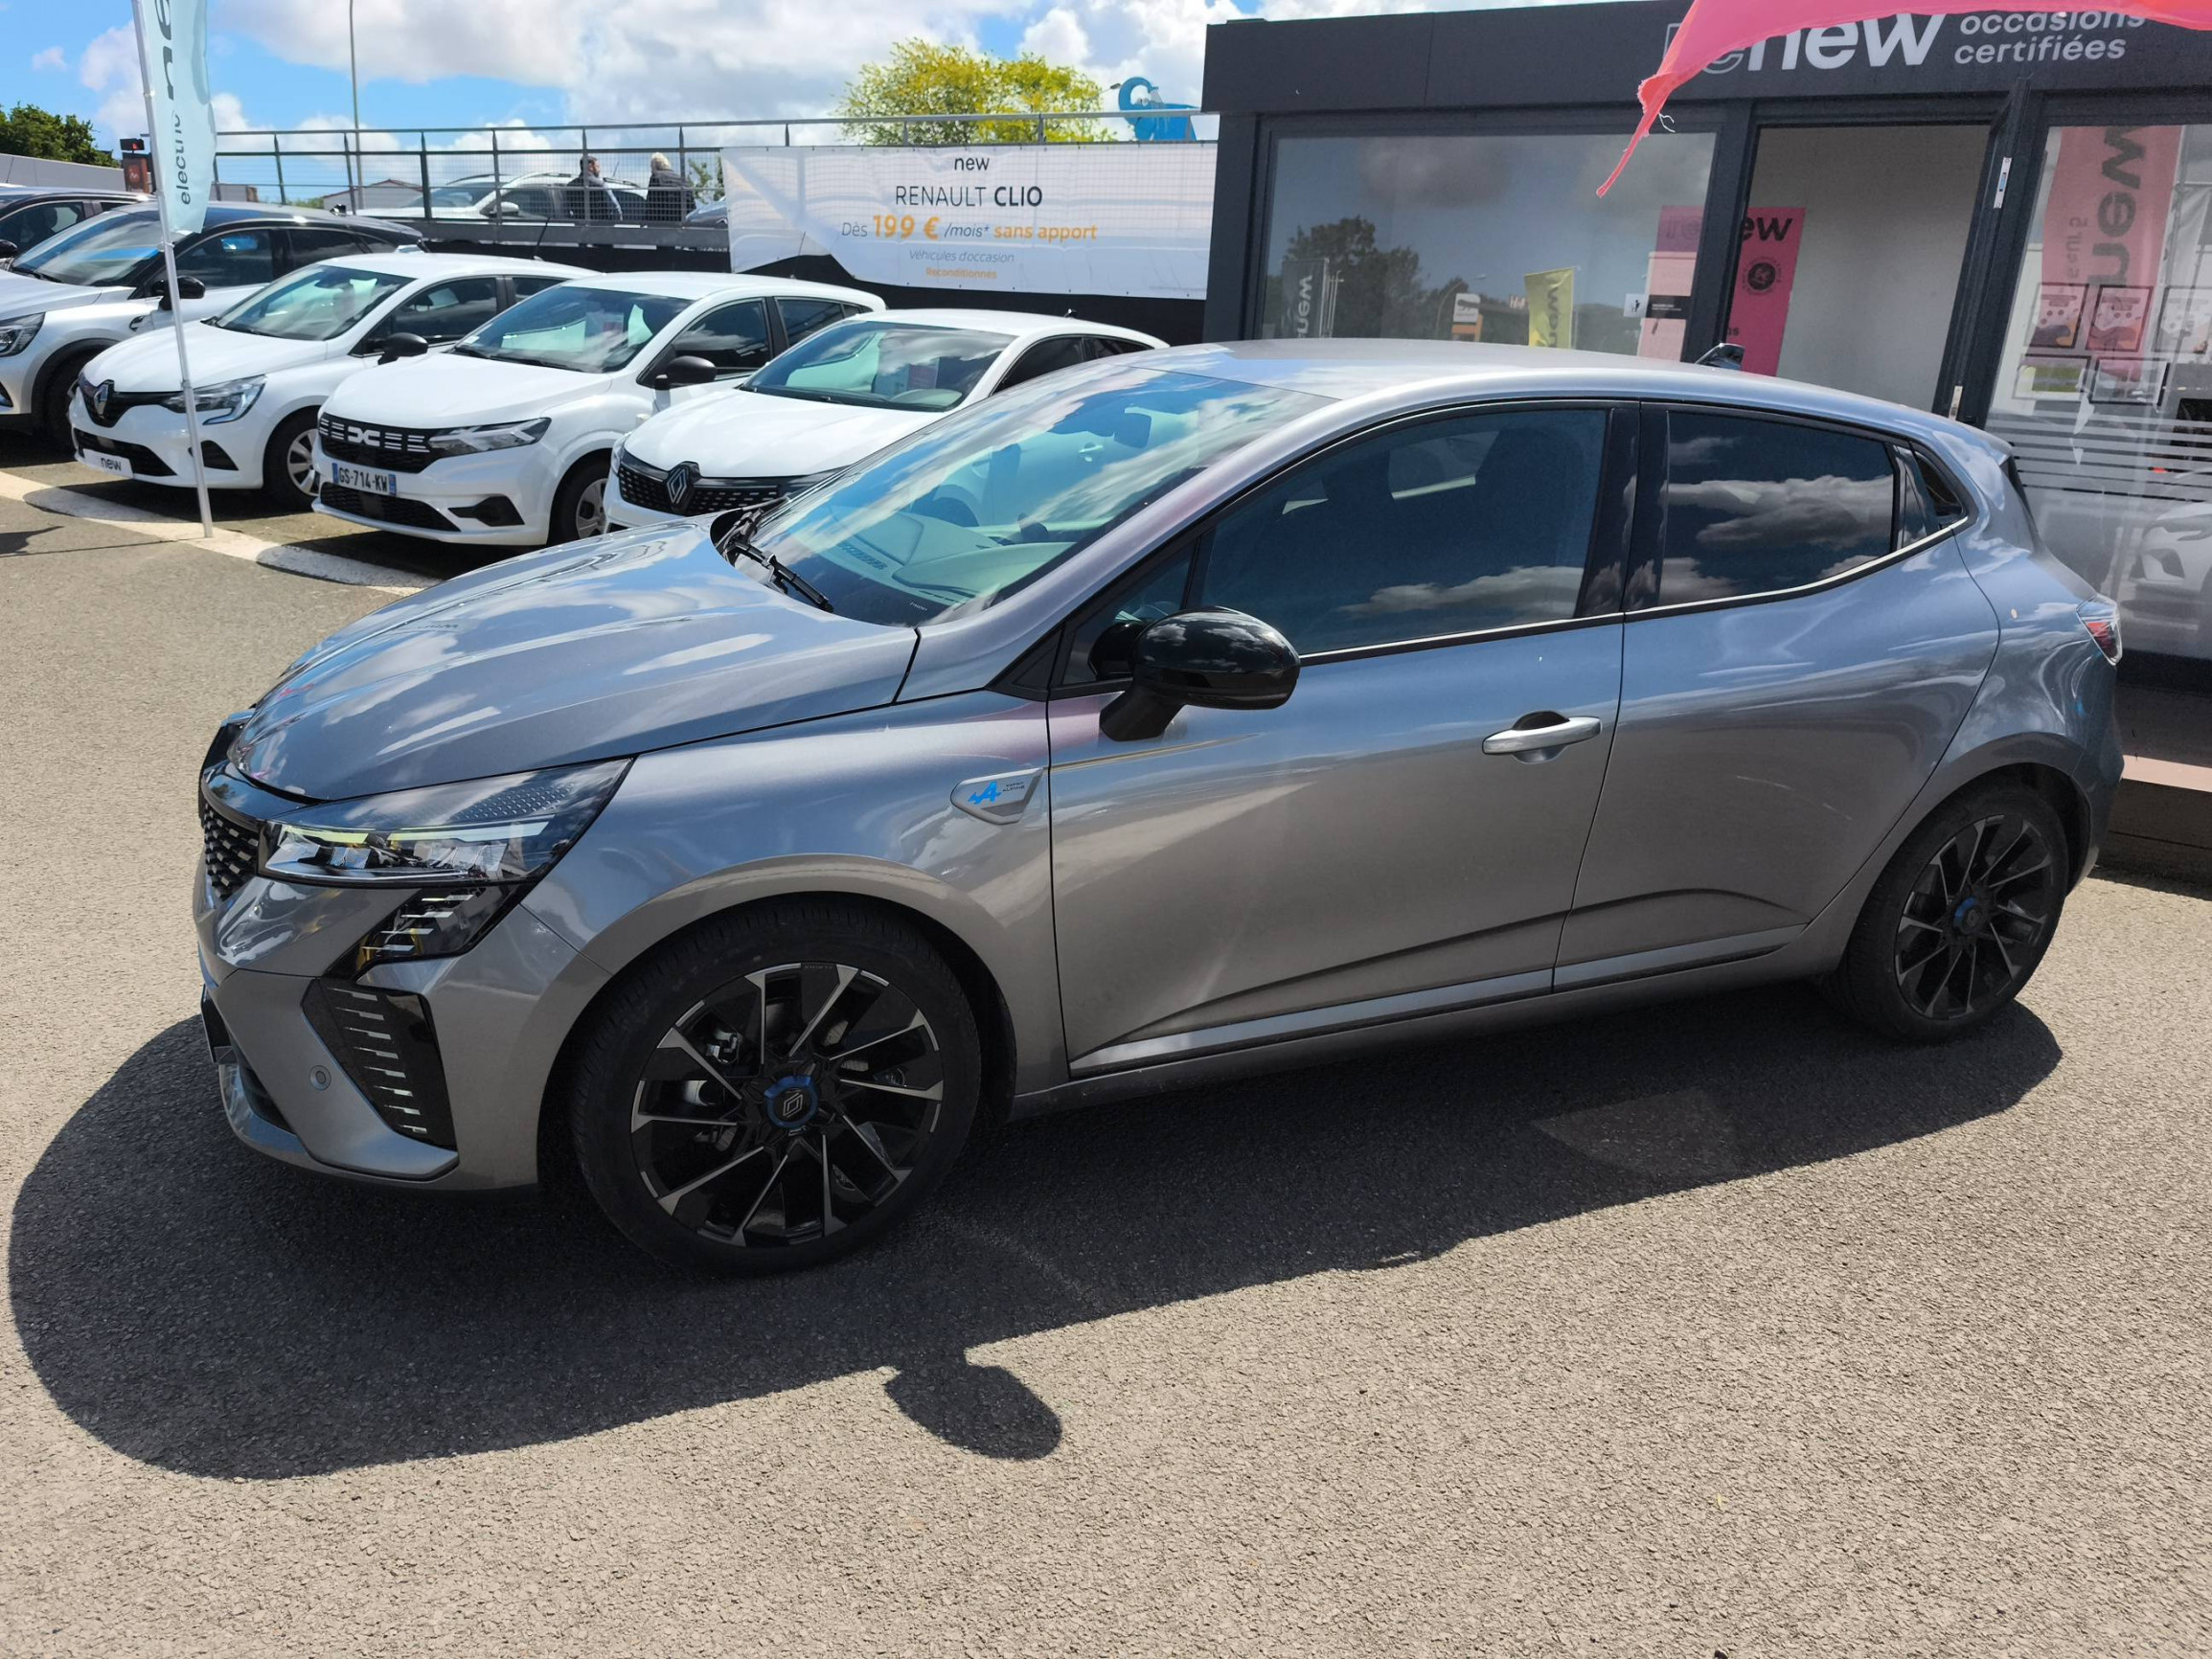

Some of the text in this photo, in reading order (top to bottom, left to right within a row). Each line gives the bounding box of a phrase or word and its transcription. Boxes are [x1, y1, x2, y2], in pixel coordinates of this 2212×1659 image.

[1662, 12, 1947, 74] new
[1954, 34, 2127, 64] certifiées
[954, 157, 990, 171] new
[895, 185, 1043, 207] RENAULT CLIO
[841, 220, 868, 238] Dès
[873, 214, 915, 239] 199
[923, 216, 941, 239] €
[993, 225, 1033, 239] sans
[1038, 224, 1098, 243] apport
[101, 457, 122, 471] new
[339, 466, 388, 492] GS-714-KW
